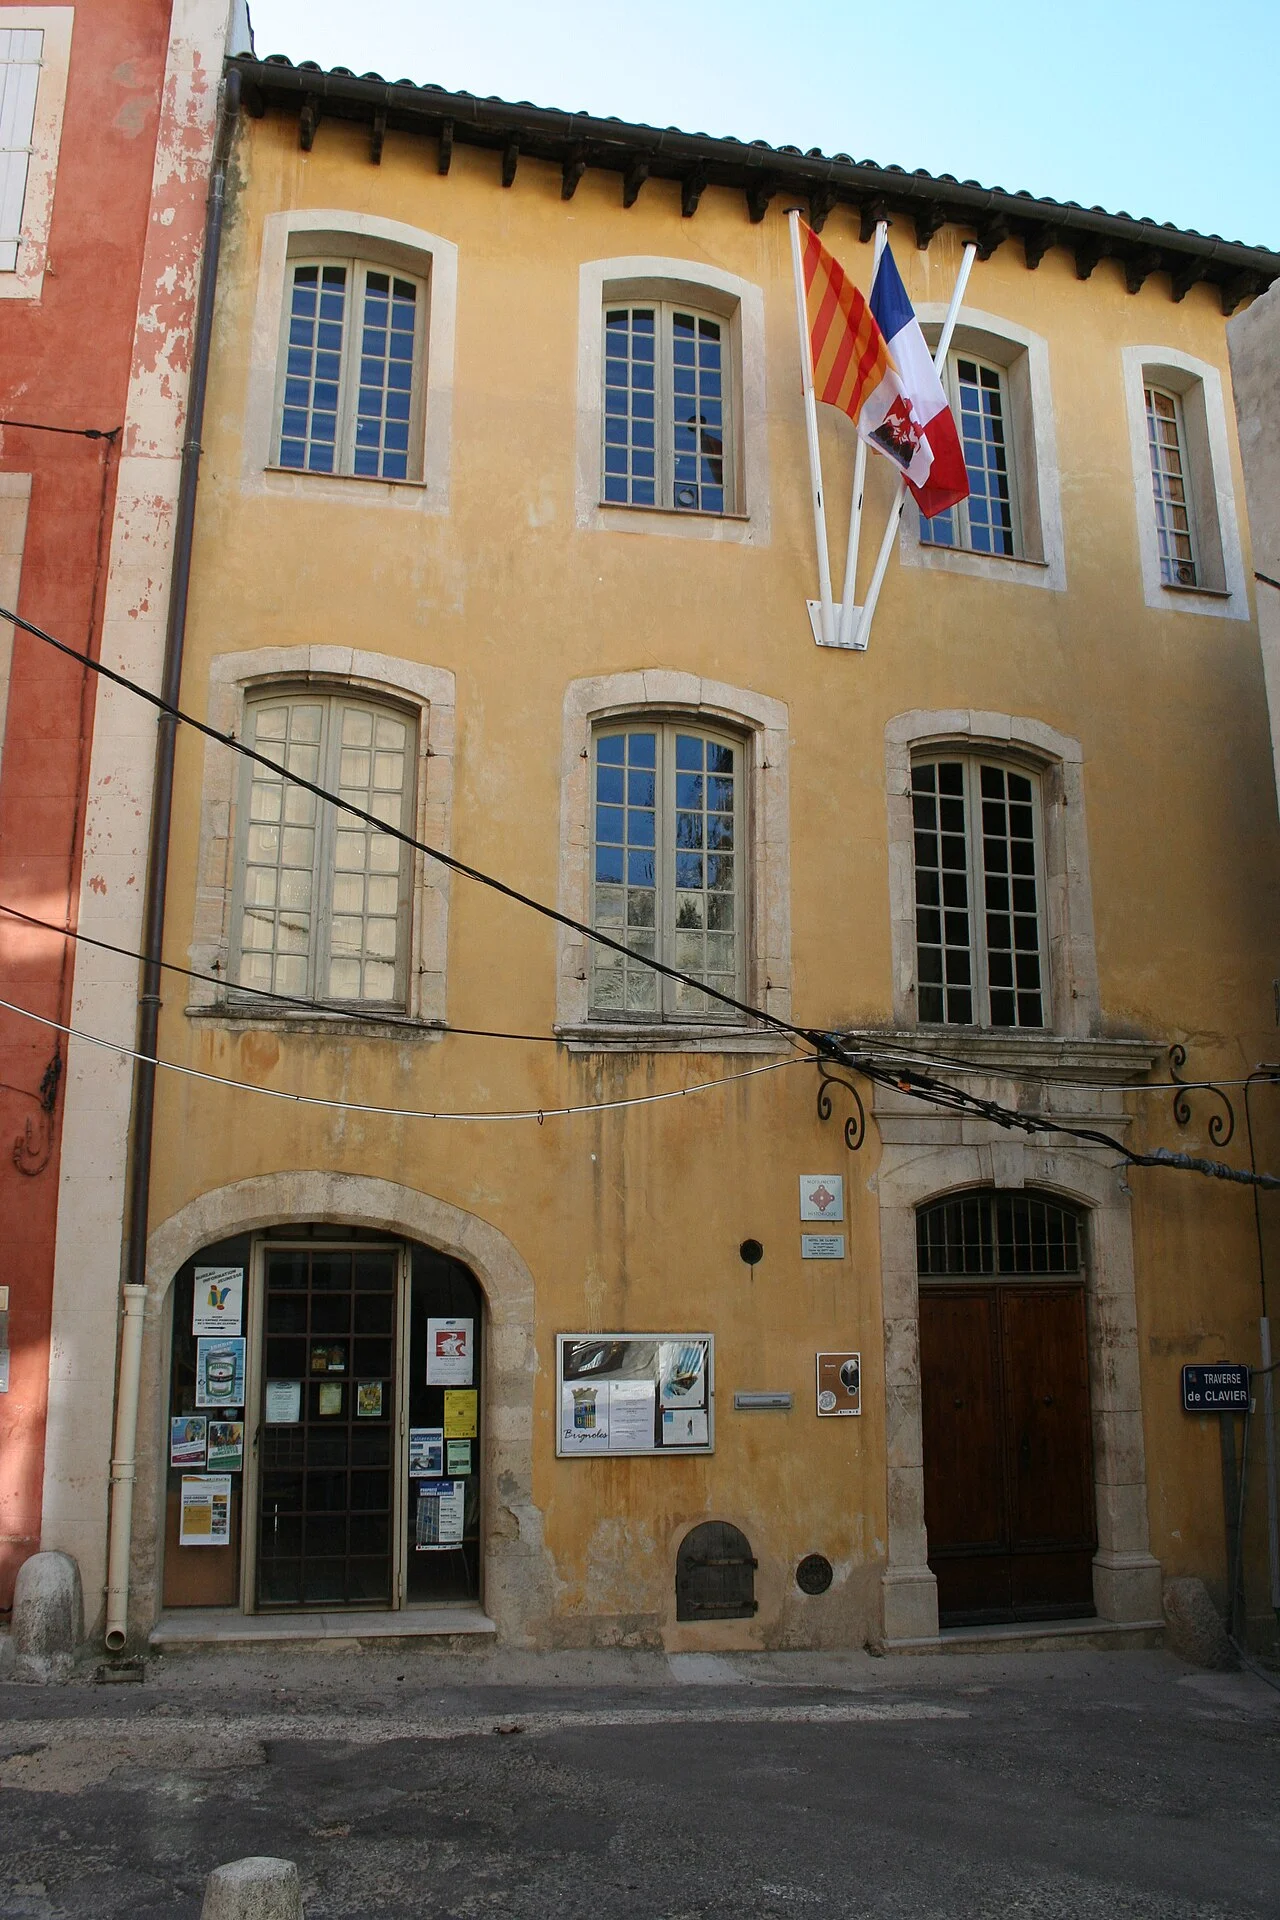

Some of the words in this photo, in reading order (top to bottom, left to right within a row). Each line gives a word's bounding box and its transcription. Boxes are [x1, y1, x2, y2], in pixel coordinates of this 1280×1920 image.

[1204, 1373, 1241, 1384] TRAVERSE
[1187, 1391, 1201, 1402] de
[1204, 1390, 1247, 1402] CLAVIER
[564, 1428, 608, 1443] Brignoles
